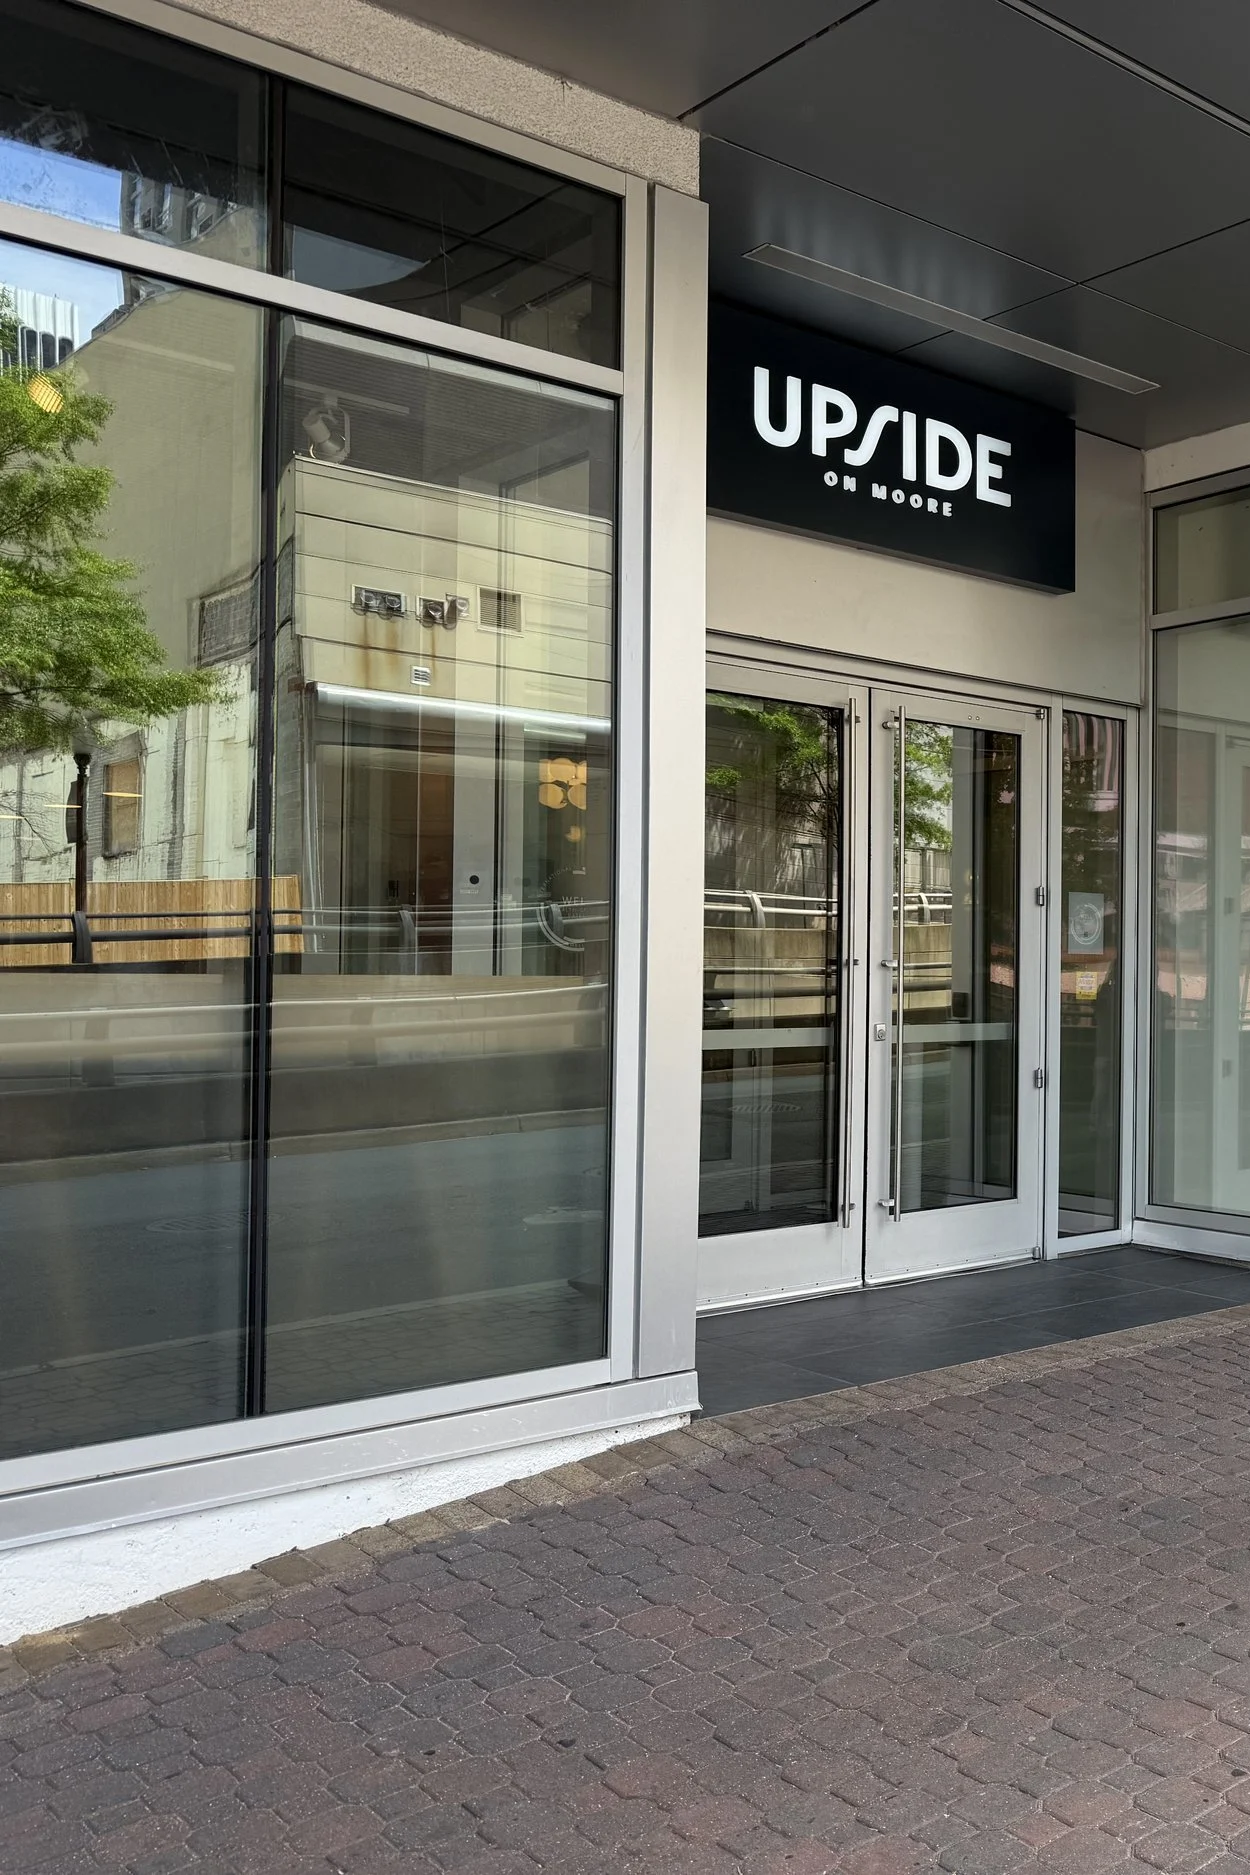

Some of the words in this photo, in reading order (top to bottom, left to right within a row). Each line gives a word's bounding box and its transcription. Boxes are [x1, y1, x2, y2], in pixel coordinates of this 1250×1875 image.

[754, 366, 1011, 507] UPSIDE
[824, 471, 856, 492] ON
[871, 483, 952, 517] MOORE
